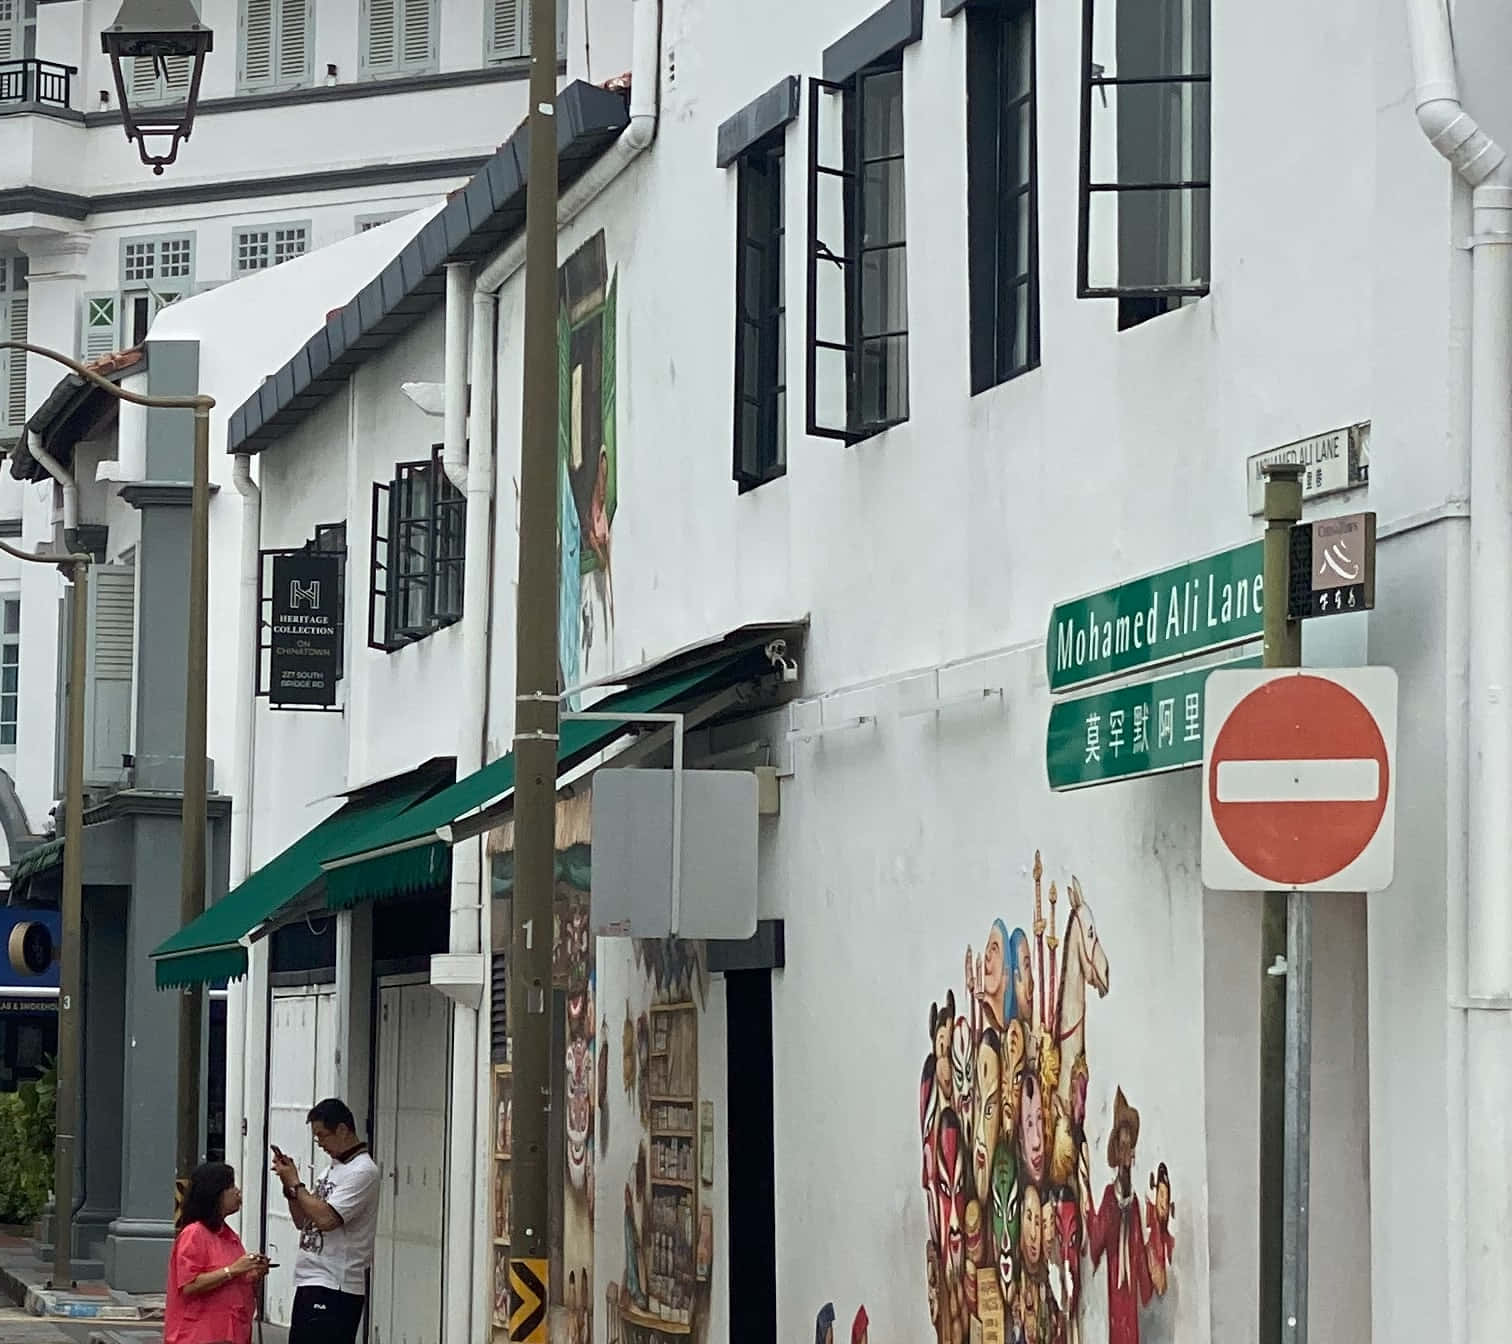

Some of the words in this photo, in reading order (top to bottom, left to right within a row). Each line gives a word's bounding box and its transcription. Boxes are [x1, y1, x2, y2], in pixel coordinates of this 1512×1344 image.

[1300, 442, 1313, 465] ALI
[1316, 436, 1339, 463] LANE
[279, 614, 329, 624] HERITAGE
[1057, 591, 1158, 672] Mohamed
[1166, 578, 1199, 640] Ali
[1207, 573, 1264, 628] Lane
[273, 625, 334, 635] COLLECTION
[63, 995, 71, 1010] 3
